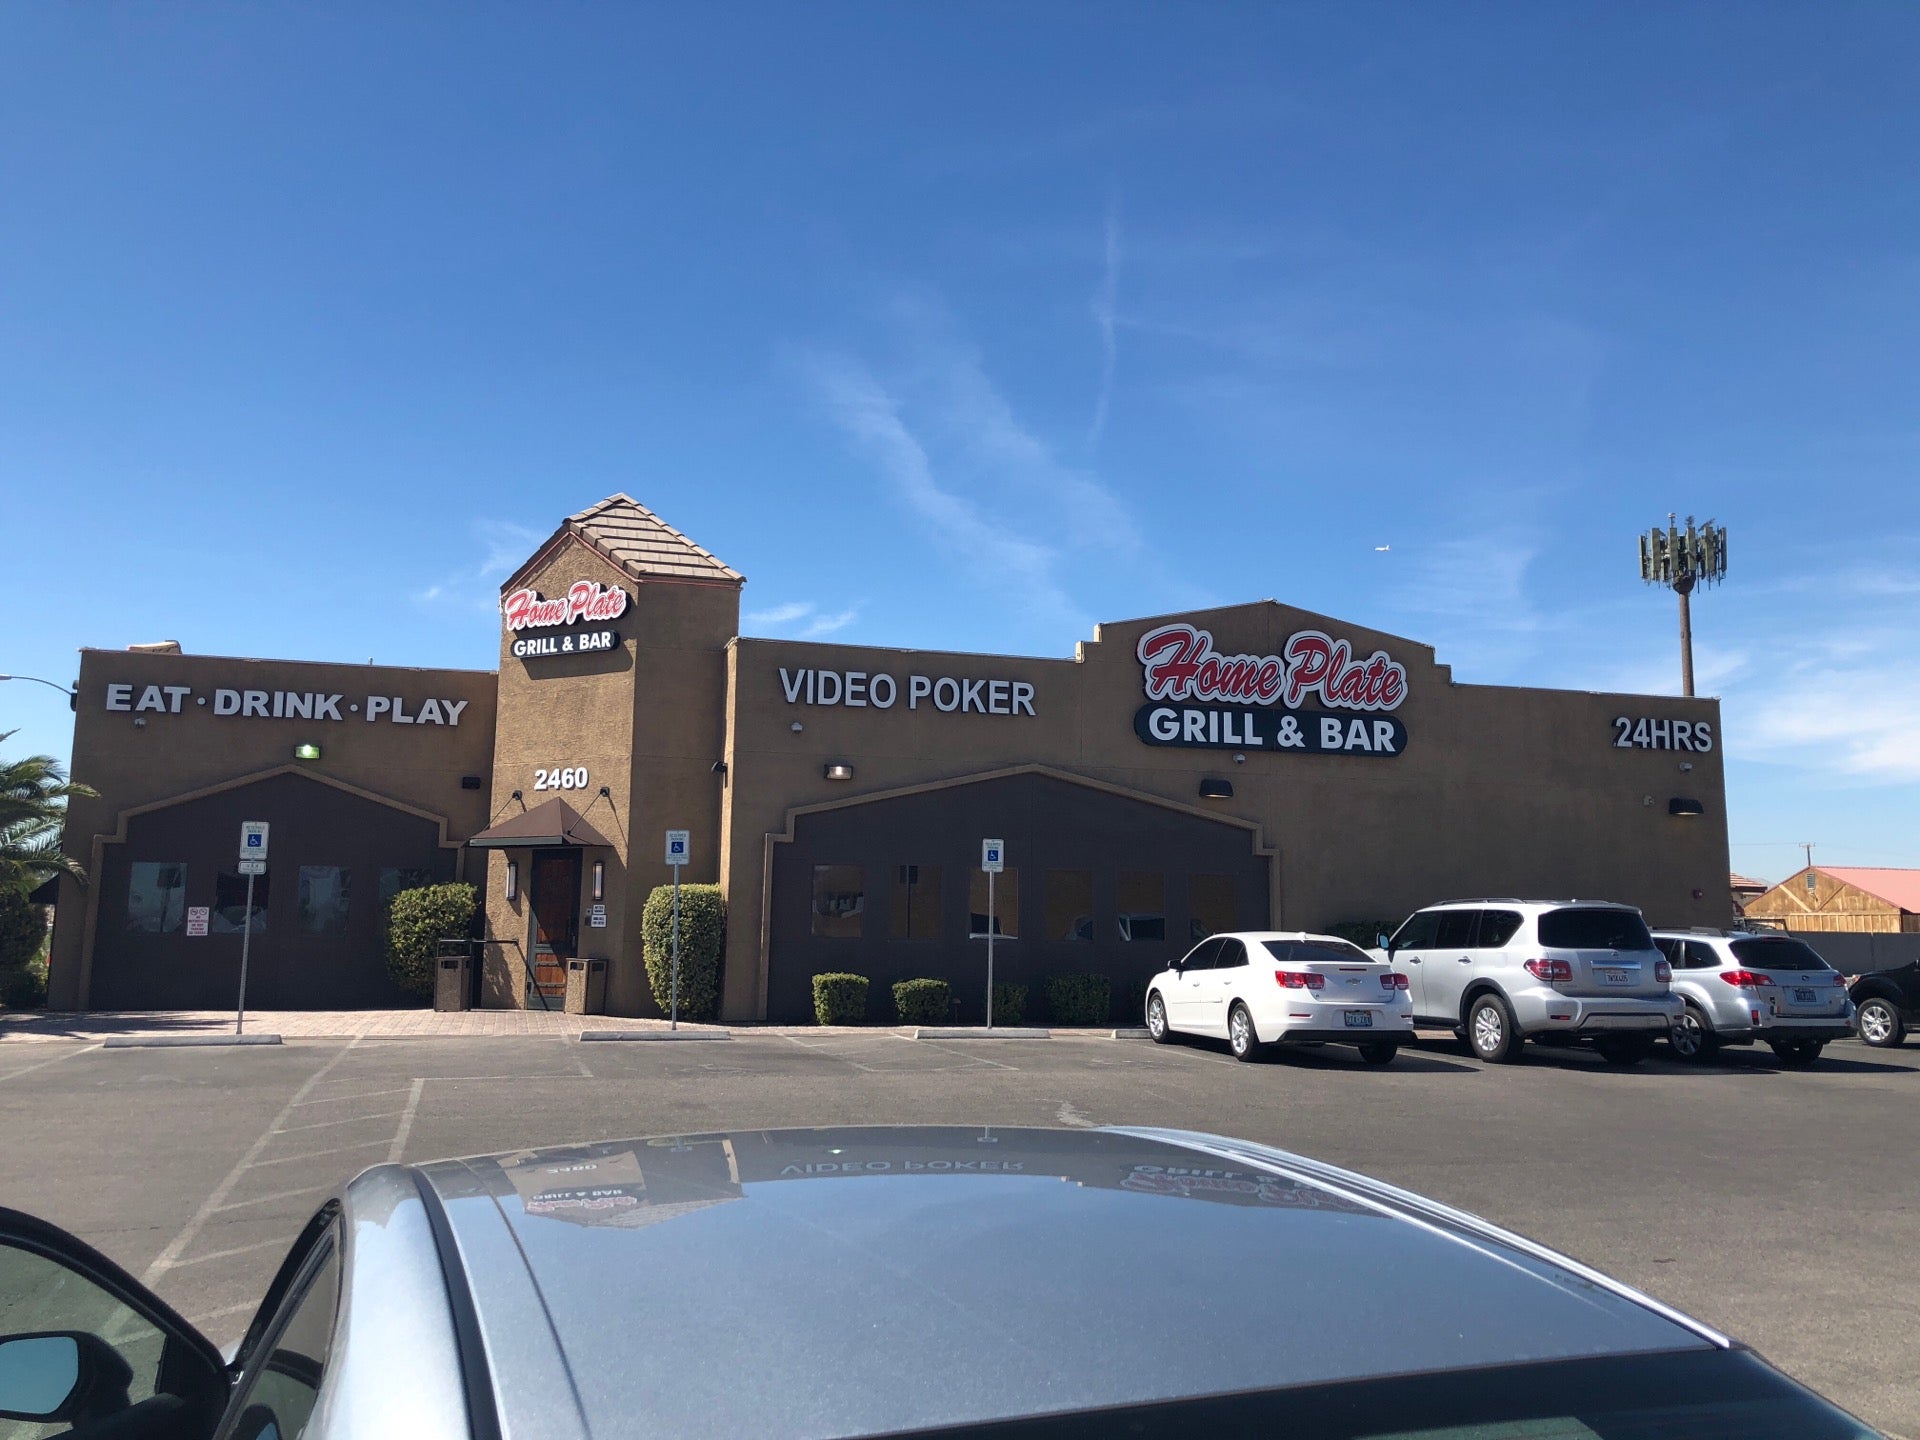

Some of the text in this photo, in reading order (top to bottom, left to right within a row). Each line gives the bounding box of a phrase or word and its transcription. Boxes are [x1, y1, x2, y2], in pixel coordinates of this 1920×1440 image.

[506, 581, 627, 630] Home Plate
[513, 631, 611, 656] GRILL & BAR
[1139, 626, 1406, 709] Home Plate
[106, 683, 468, 727] EAT DRINK PLAY
[779, 667, 1037, 716] VIDEO POKER
[1148, 707, 1396, 752] GRILL & BAR
[1613, 717, 1713, 753] 24HRS
[534, 767, 589, 790] 2460
